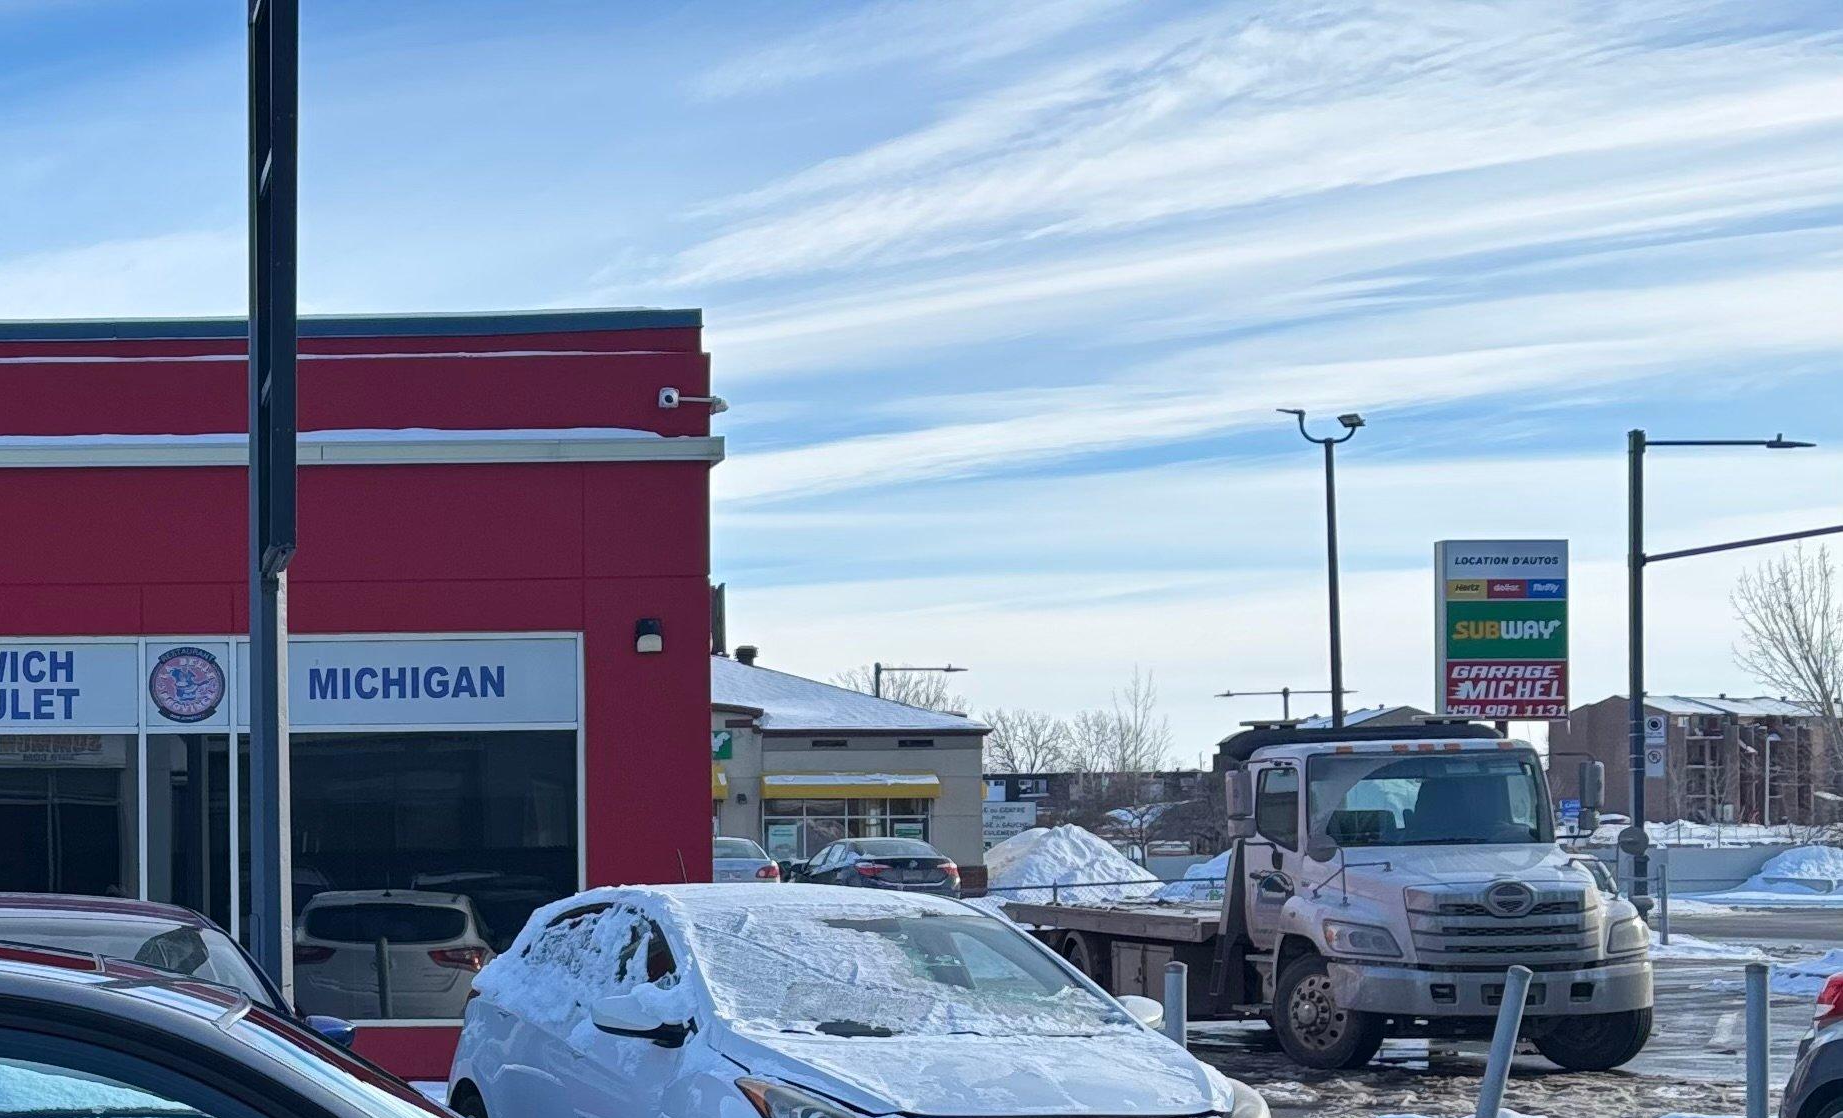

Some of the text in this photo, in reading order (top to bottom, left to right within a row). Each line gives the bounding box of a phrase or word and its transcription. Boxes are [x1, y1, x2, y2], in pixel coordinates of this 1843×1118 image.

[1454, 556, 1559, 566] LOCATION D'AUTOS
[1455, 583, 1480, 592] Hertz
[1452, 620, 1561, 640] SUBWAY
[160, 648, 215, 662] RESTAURANT
[1451, 665, 1562, 679] GARAGE
[309, 666, 505, 700] MICHIGAN
[1449, 680, 1565, 700] MICHEL
